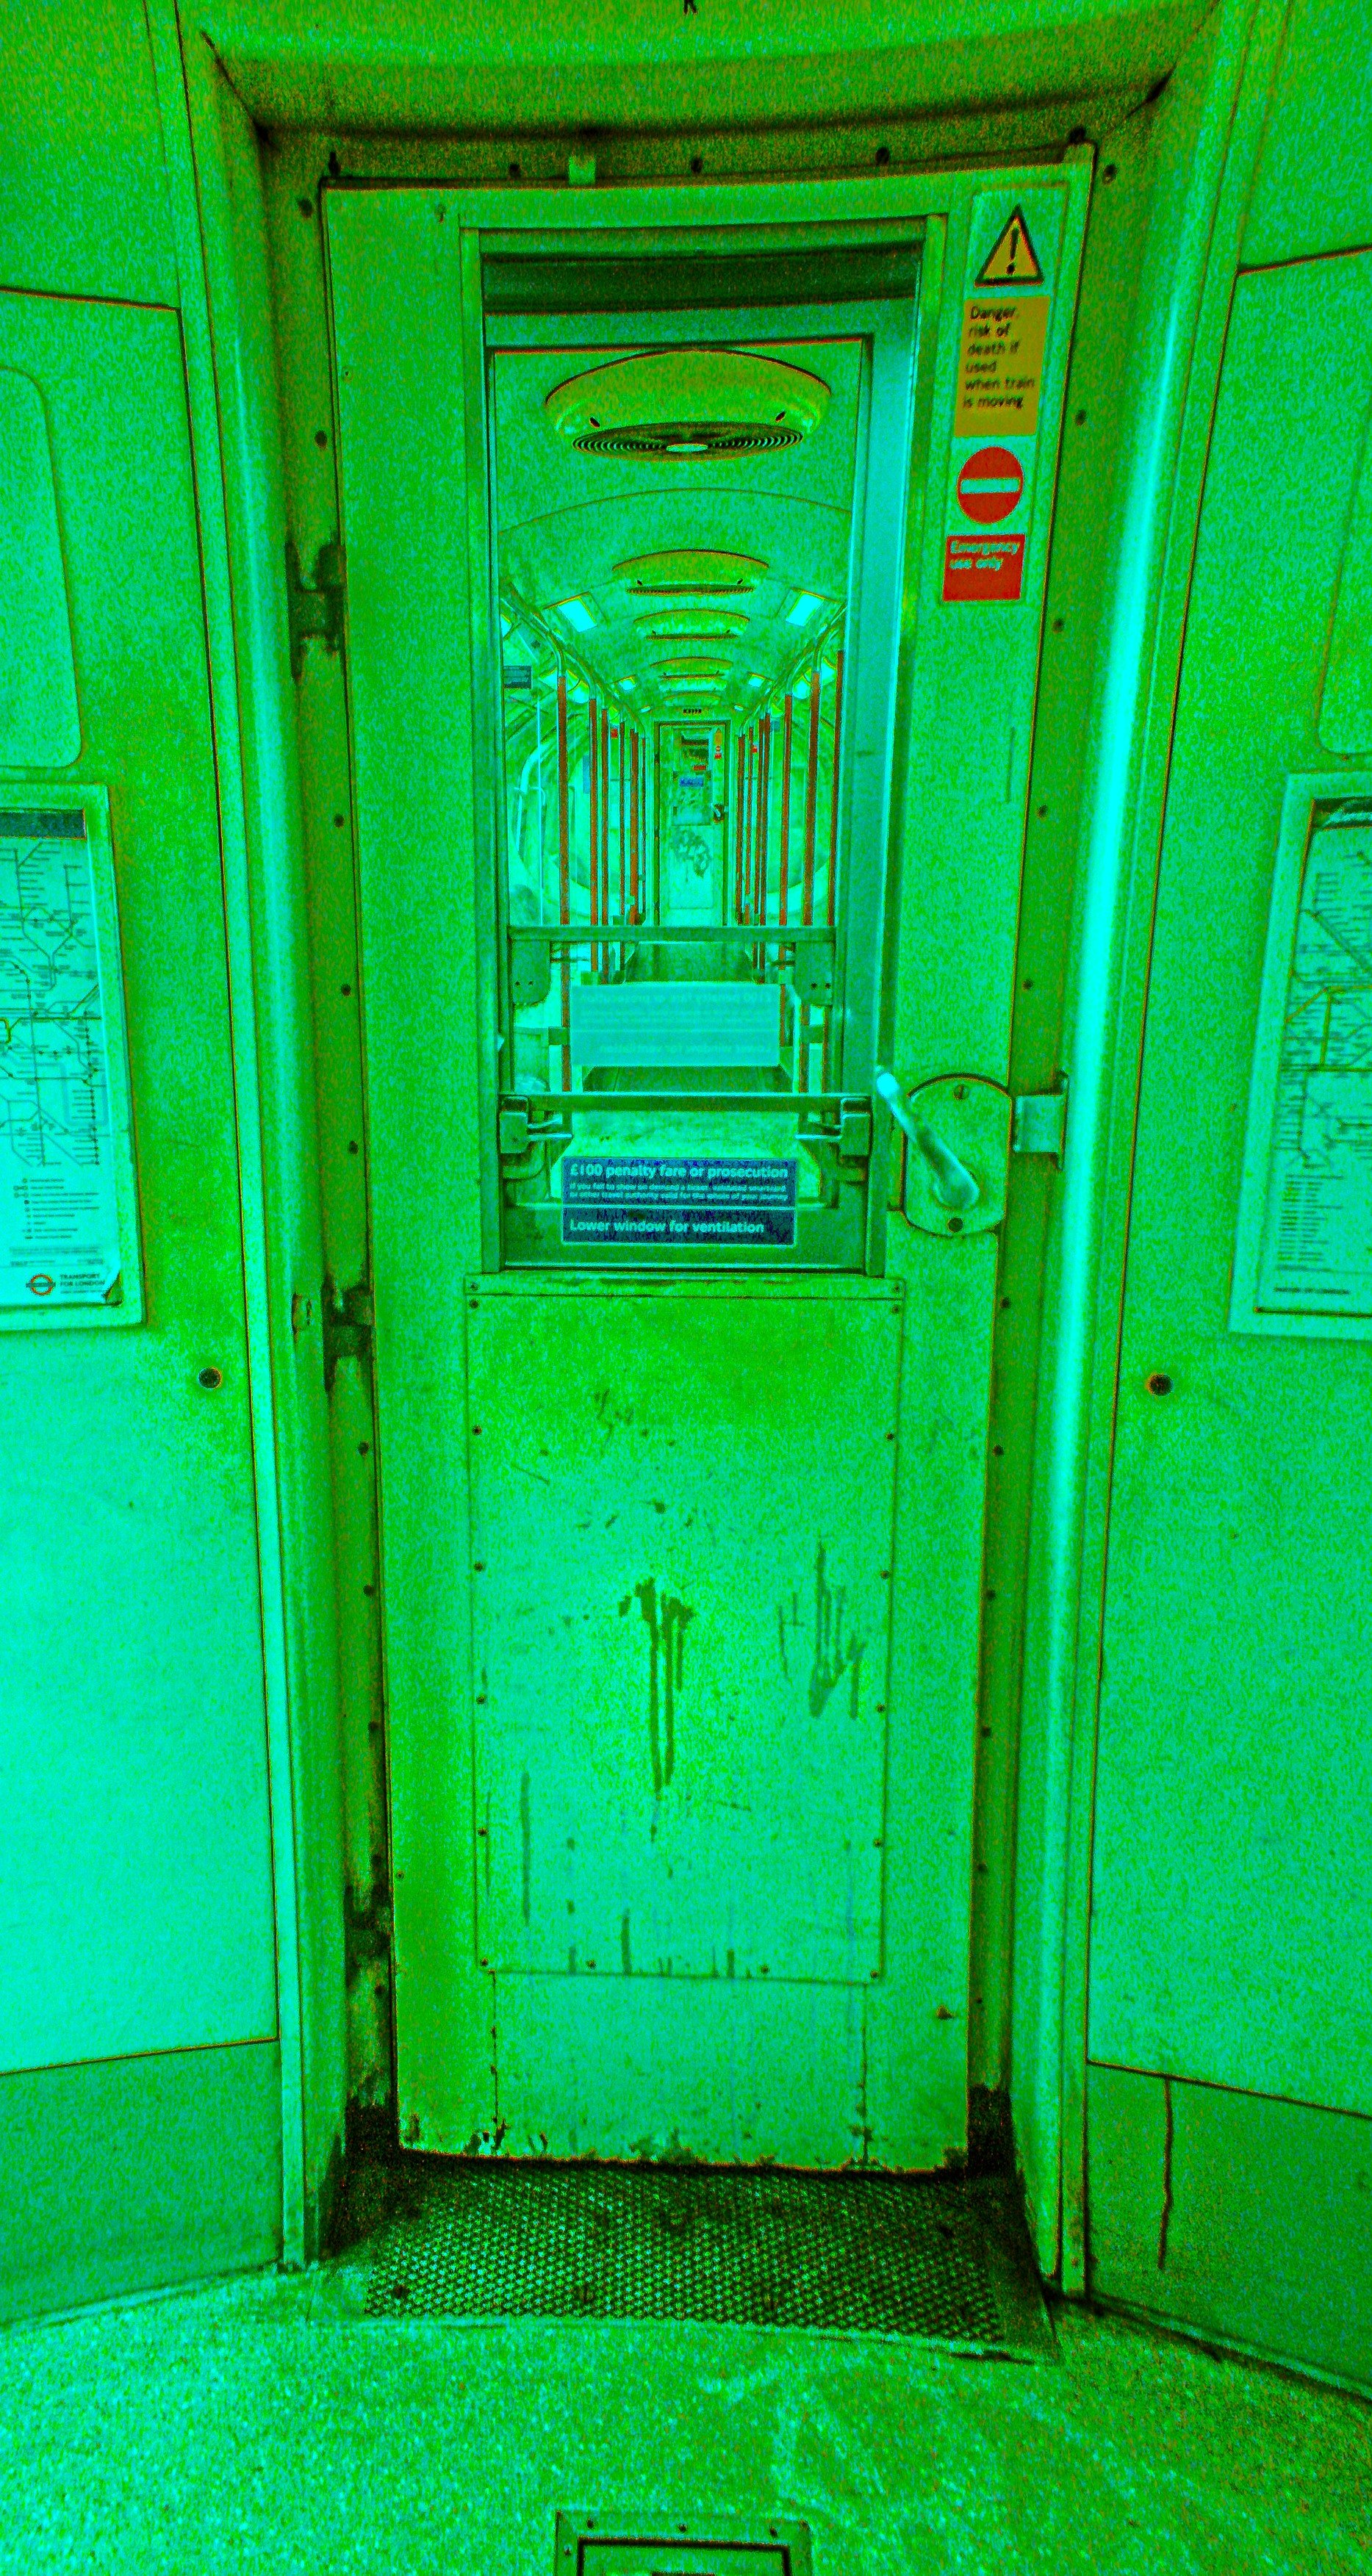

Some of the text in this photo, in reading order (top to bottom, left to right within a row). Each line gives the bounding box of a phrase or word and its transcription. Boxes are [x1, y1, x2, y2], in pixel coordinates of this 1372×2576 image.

[969, 323, 1011, 337] risk of
[966, 339, 1020, 356] death if
[965, 359, 996, 373] used
[965, 376, 1035, 391] when train
[963, 395, 1024, 410] is moving
[949, 540, 1021, 555] Emergency
[949, 556, 1004, 572] use only
[570, 1163, 788, 1179] £100 penalty fare or prosecution
[570, 1220, 764, 1234] Lower window for ventilation
